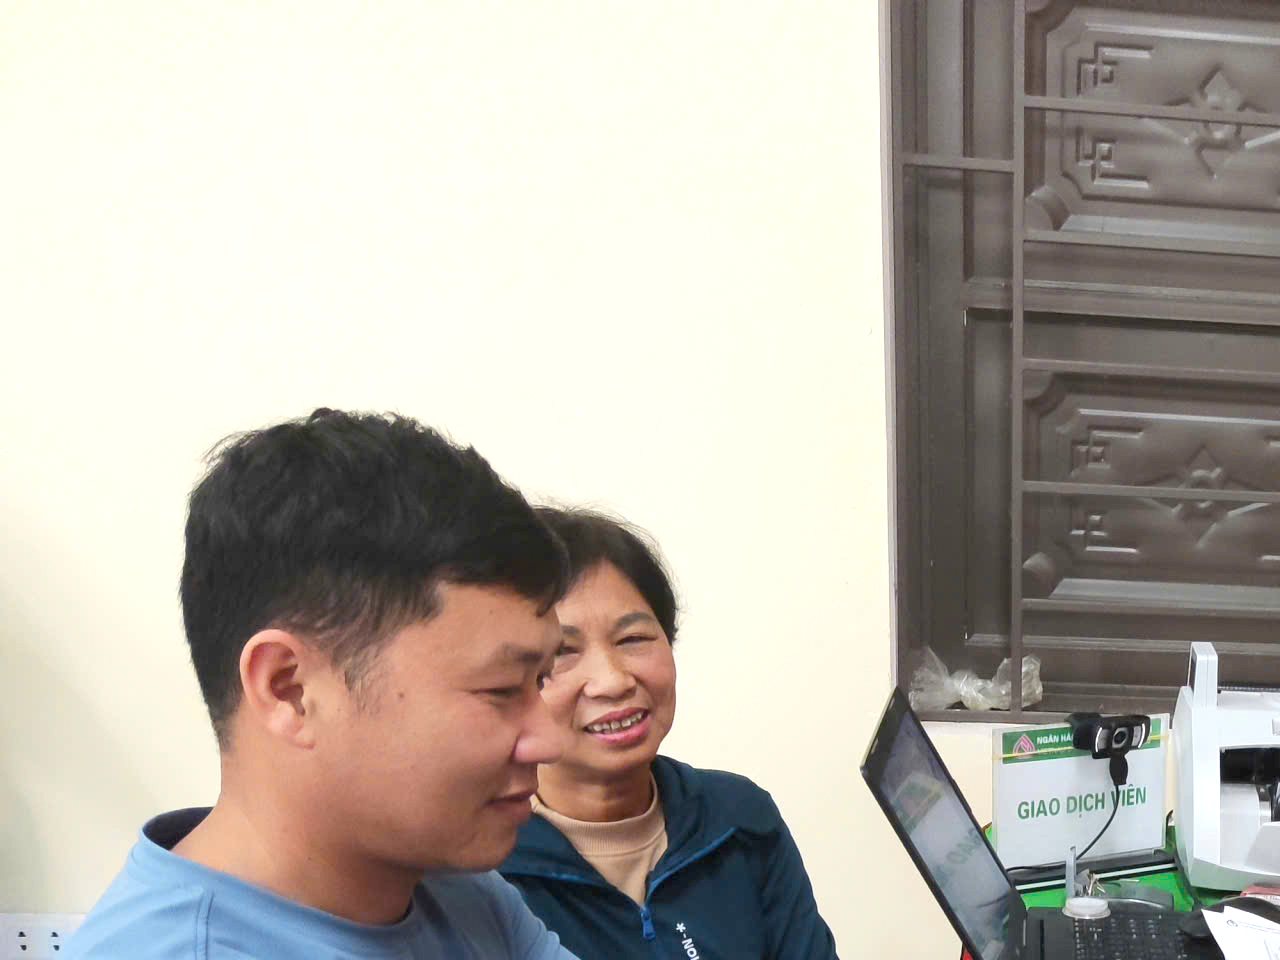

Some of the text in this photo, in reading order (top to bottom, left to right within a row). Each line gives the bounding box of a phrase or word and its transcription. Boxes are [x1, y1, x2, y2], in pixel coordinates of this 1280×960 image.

[1036, 731, 1074, 745] NGÂN HÀ
[1017, 783, 1147, 820] GIAO DỊCH VIÊN
